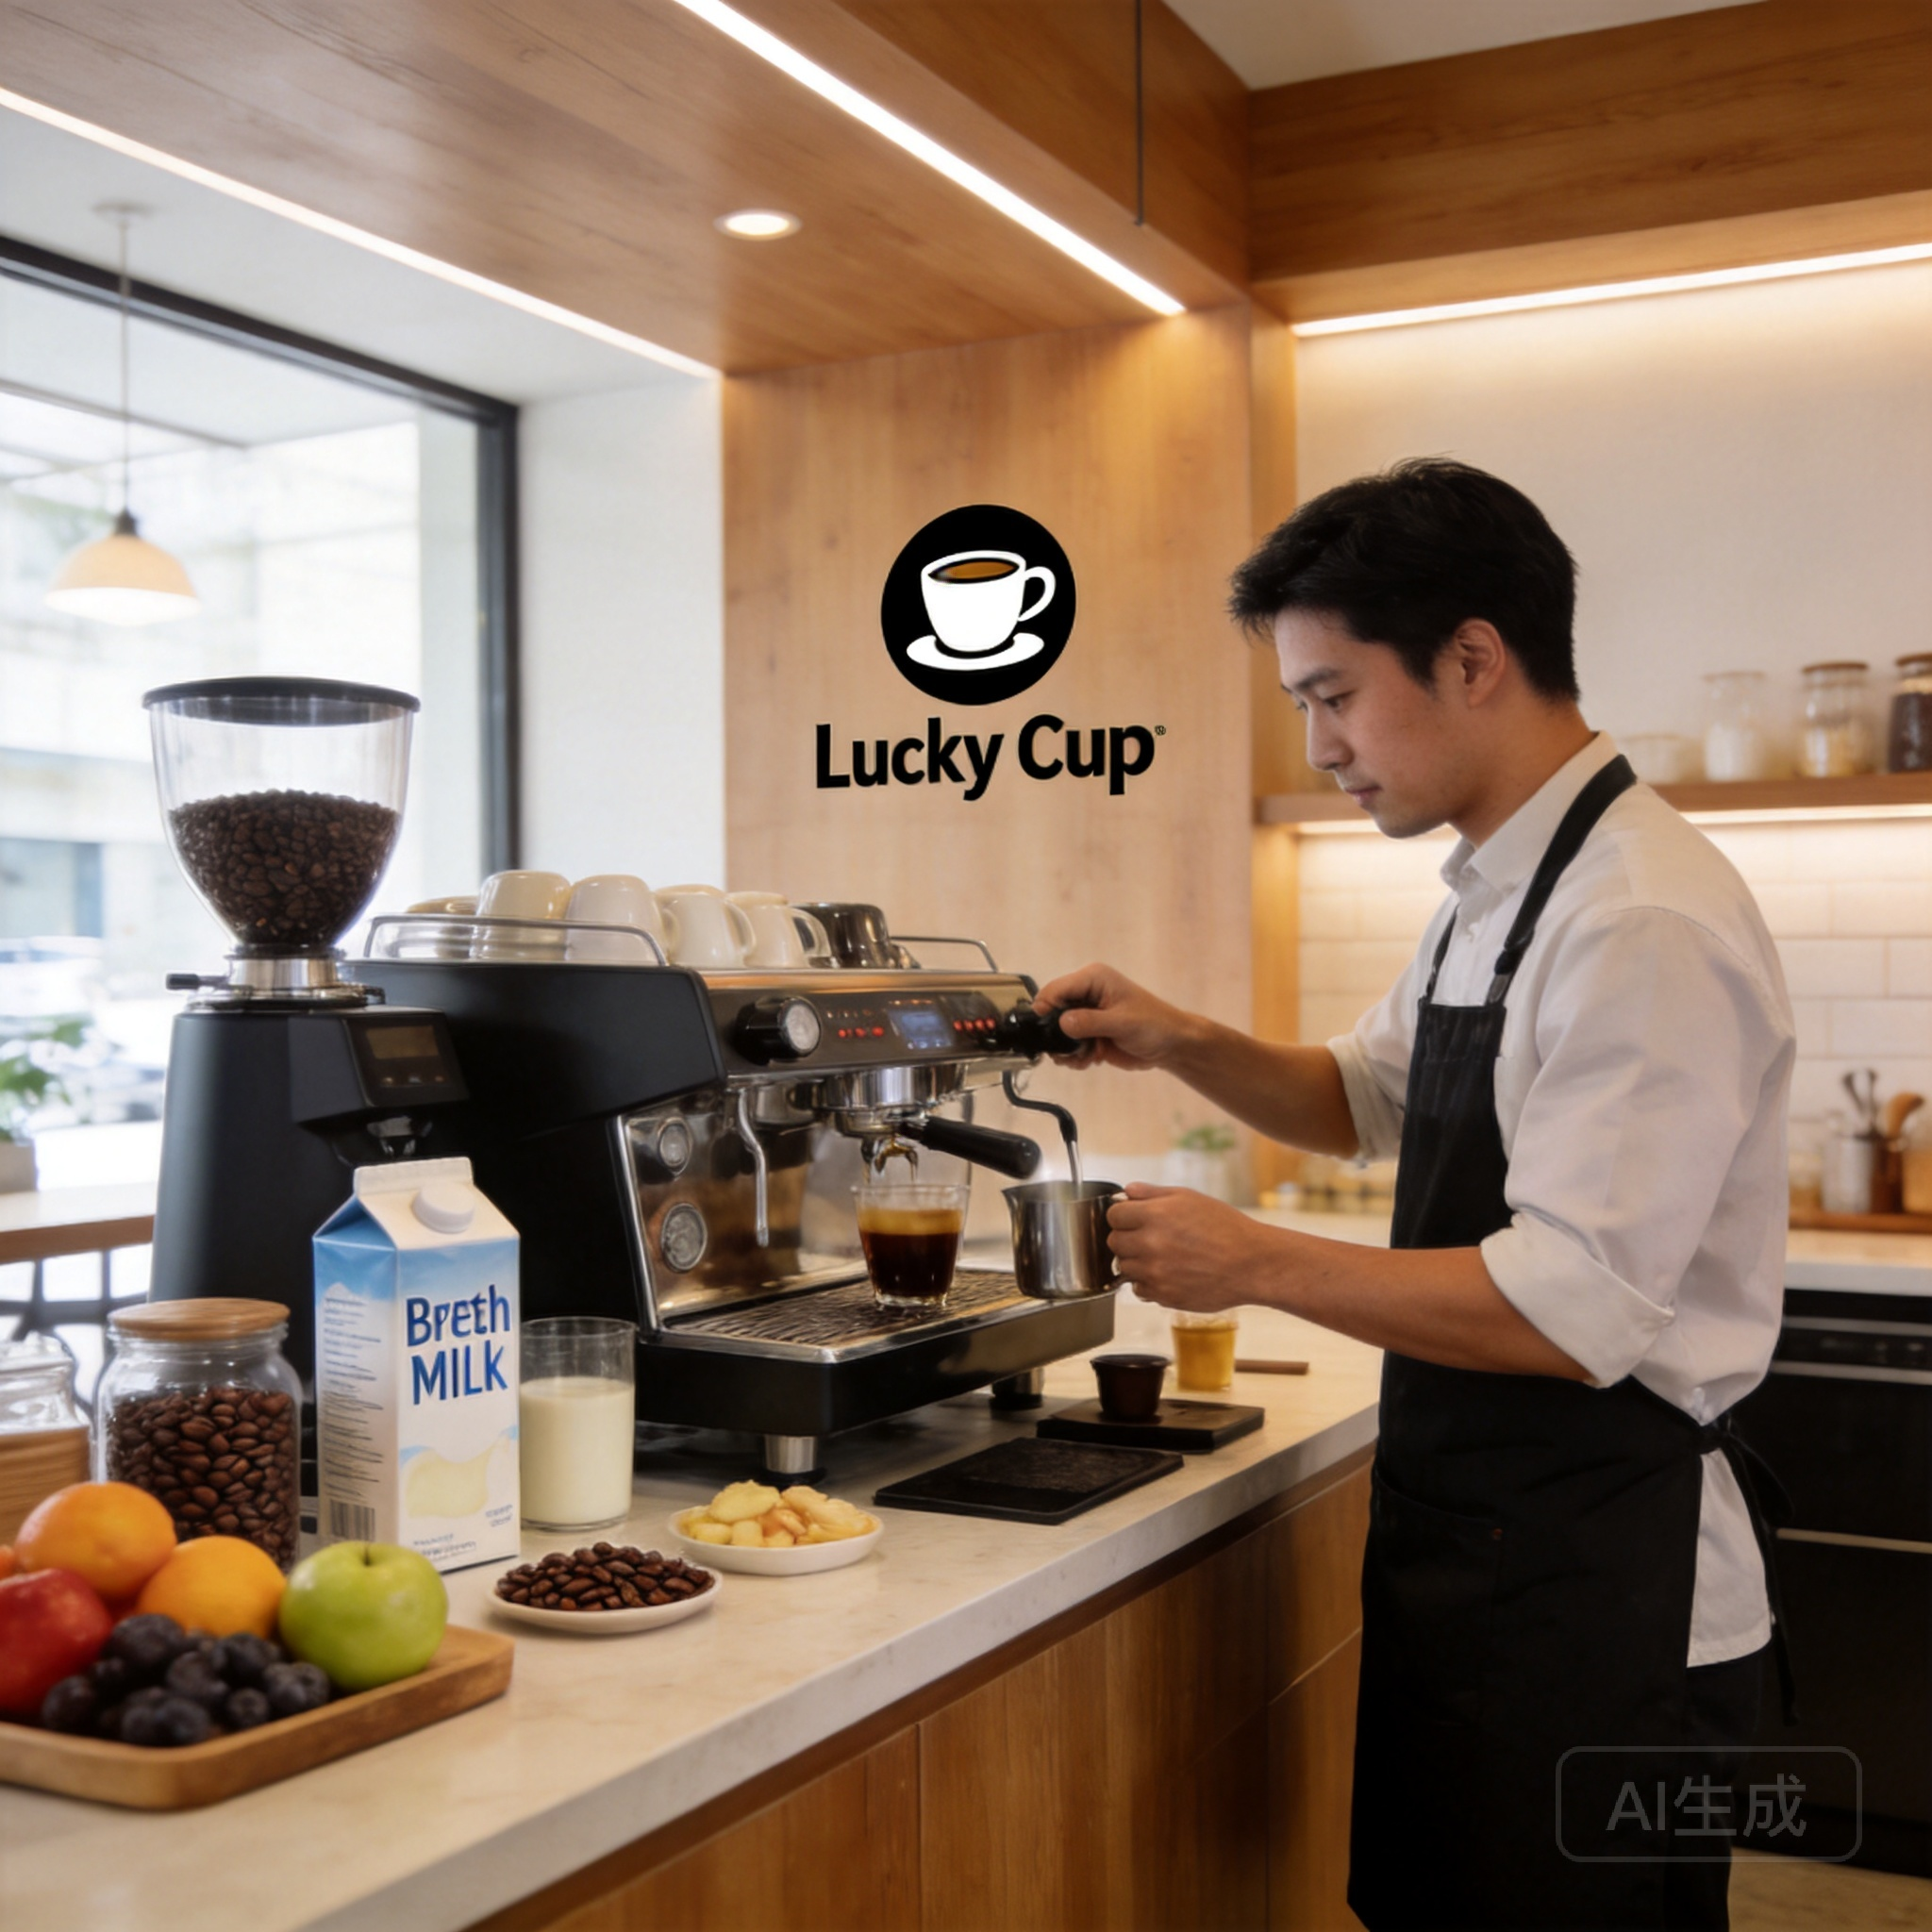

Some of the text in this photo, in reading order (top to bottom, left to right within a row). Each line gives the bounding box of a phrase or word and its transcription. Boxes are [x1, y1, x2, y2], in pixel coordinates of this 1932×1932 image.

[816, 714, 1155, 801] Lucky Cup
[411, 1340, 508, 1406] MILK
